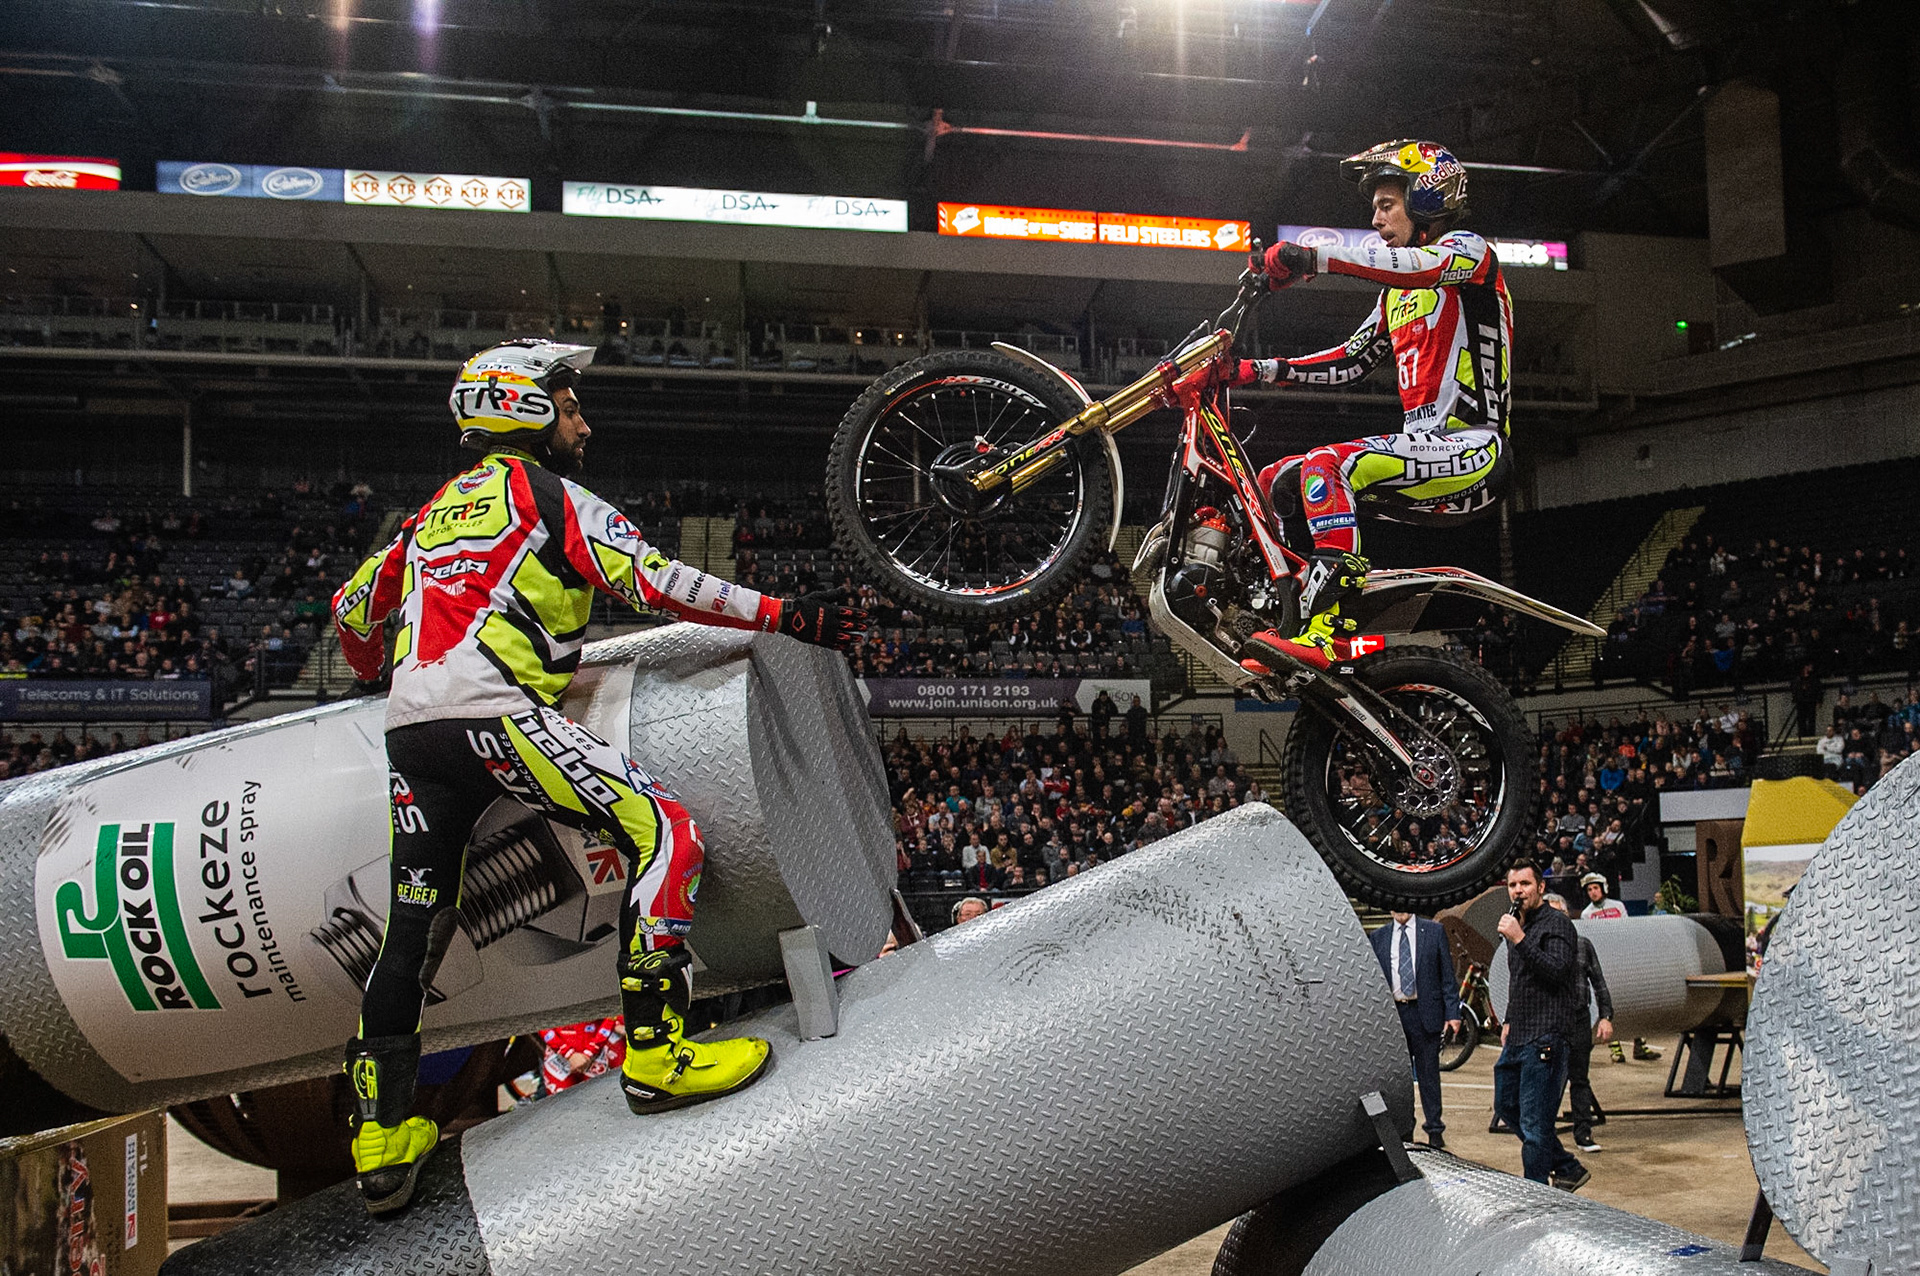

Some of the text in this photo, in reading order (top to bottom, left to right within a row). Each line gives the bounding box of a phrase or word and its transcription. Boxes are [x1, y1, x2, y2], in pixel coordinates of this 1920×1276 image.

[351, 180, 525, 200] KTR KTR KTR KTR KTR
[1419, 167, 1448, 191] Red
[606, 187, 652, 205] DSA
[722, 194, 767, 211] DSA
[835, 200, 879, 216] DSA
[1139, 226, 1212, 248] STEELERS
[1439, 266, 1474, 283] hebo
[1286, 363, 1364, 386] hebo
[1398, 347, 1419, 390] 67
[1404, 446, 1493, 481] hebo
[18, 687, 200, 702] Telecoms & IT Solutions
[917, 684, 1031, 697] 0800 171 2193
[888, 696, 1059, 710] www.join.unison.org.uk
[511, 709, 619, 806] hebo
[499, 732, 557, 812] MOTORCYCLES
[199, 800, 273, 999] rockeze
[239, 780, 307, 1003] maintenance spray
[120, 823, 194, 1009] ROCK OIL
